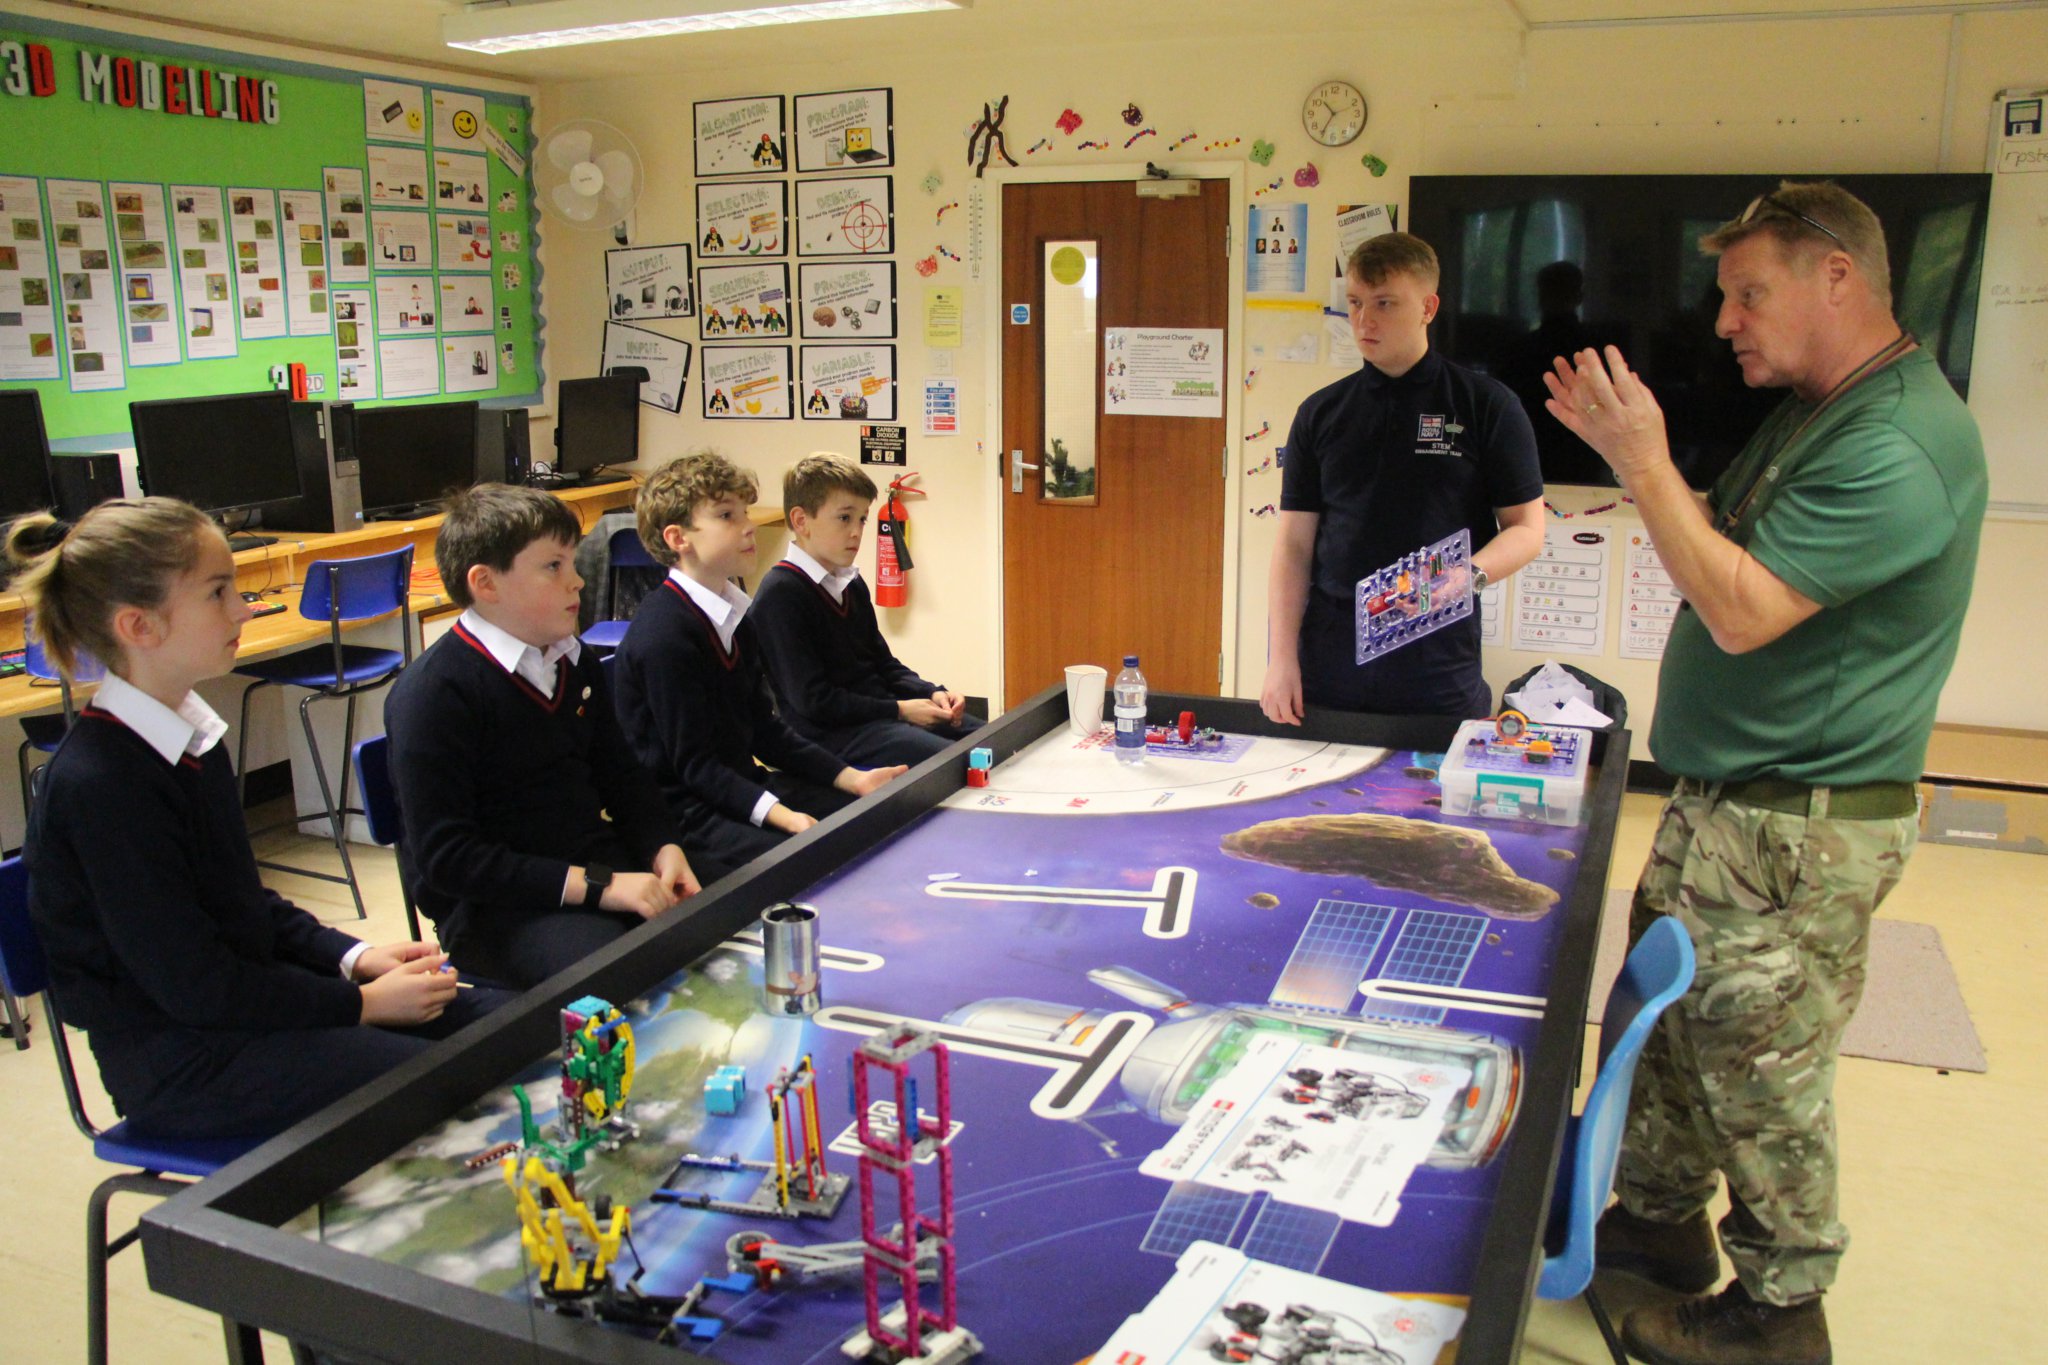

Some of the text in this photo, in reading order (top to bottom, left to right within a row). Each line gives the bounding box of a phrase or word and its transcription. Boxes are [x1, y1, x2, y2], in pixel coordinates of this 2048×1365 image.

[0, 41, 280, 125] 3D MODELLING
[1331, 86, 1340, 94] 12
[1312, 99, 1322, 107] 10
[1352, 98, 1358, 106] 2
[1308, 110, 1314, 119] 9
[1354, 110, 1360, 118] 3
[1312, 122, 1318, 130] 8
[1330, 132, 1336, 142] 6
[1338, 208, 1381, 227] CLASSROOM RULES
